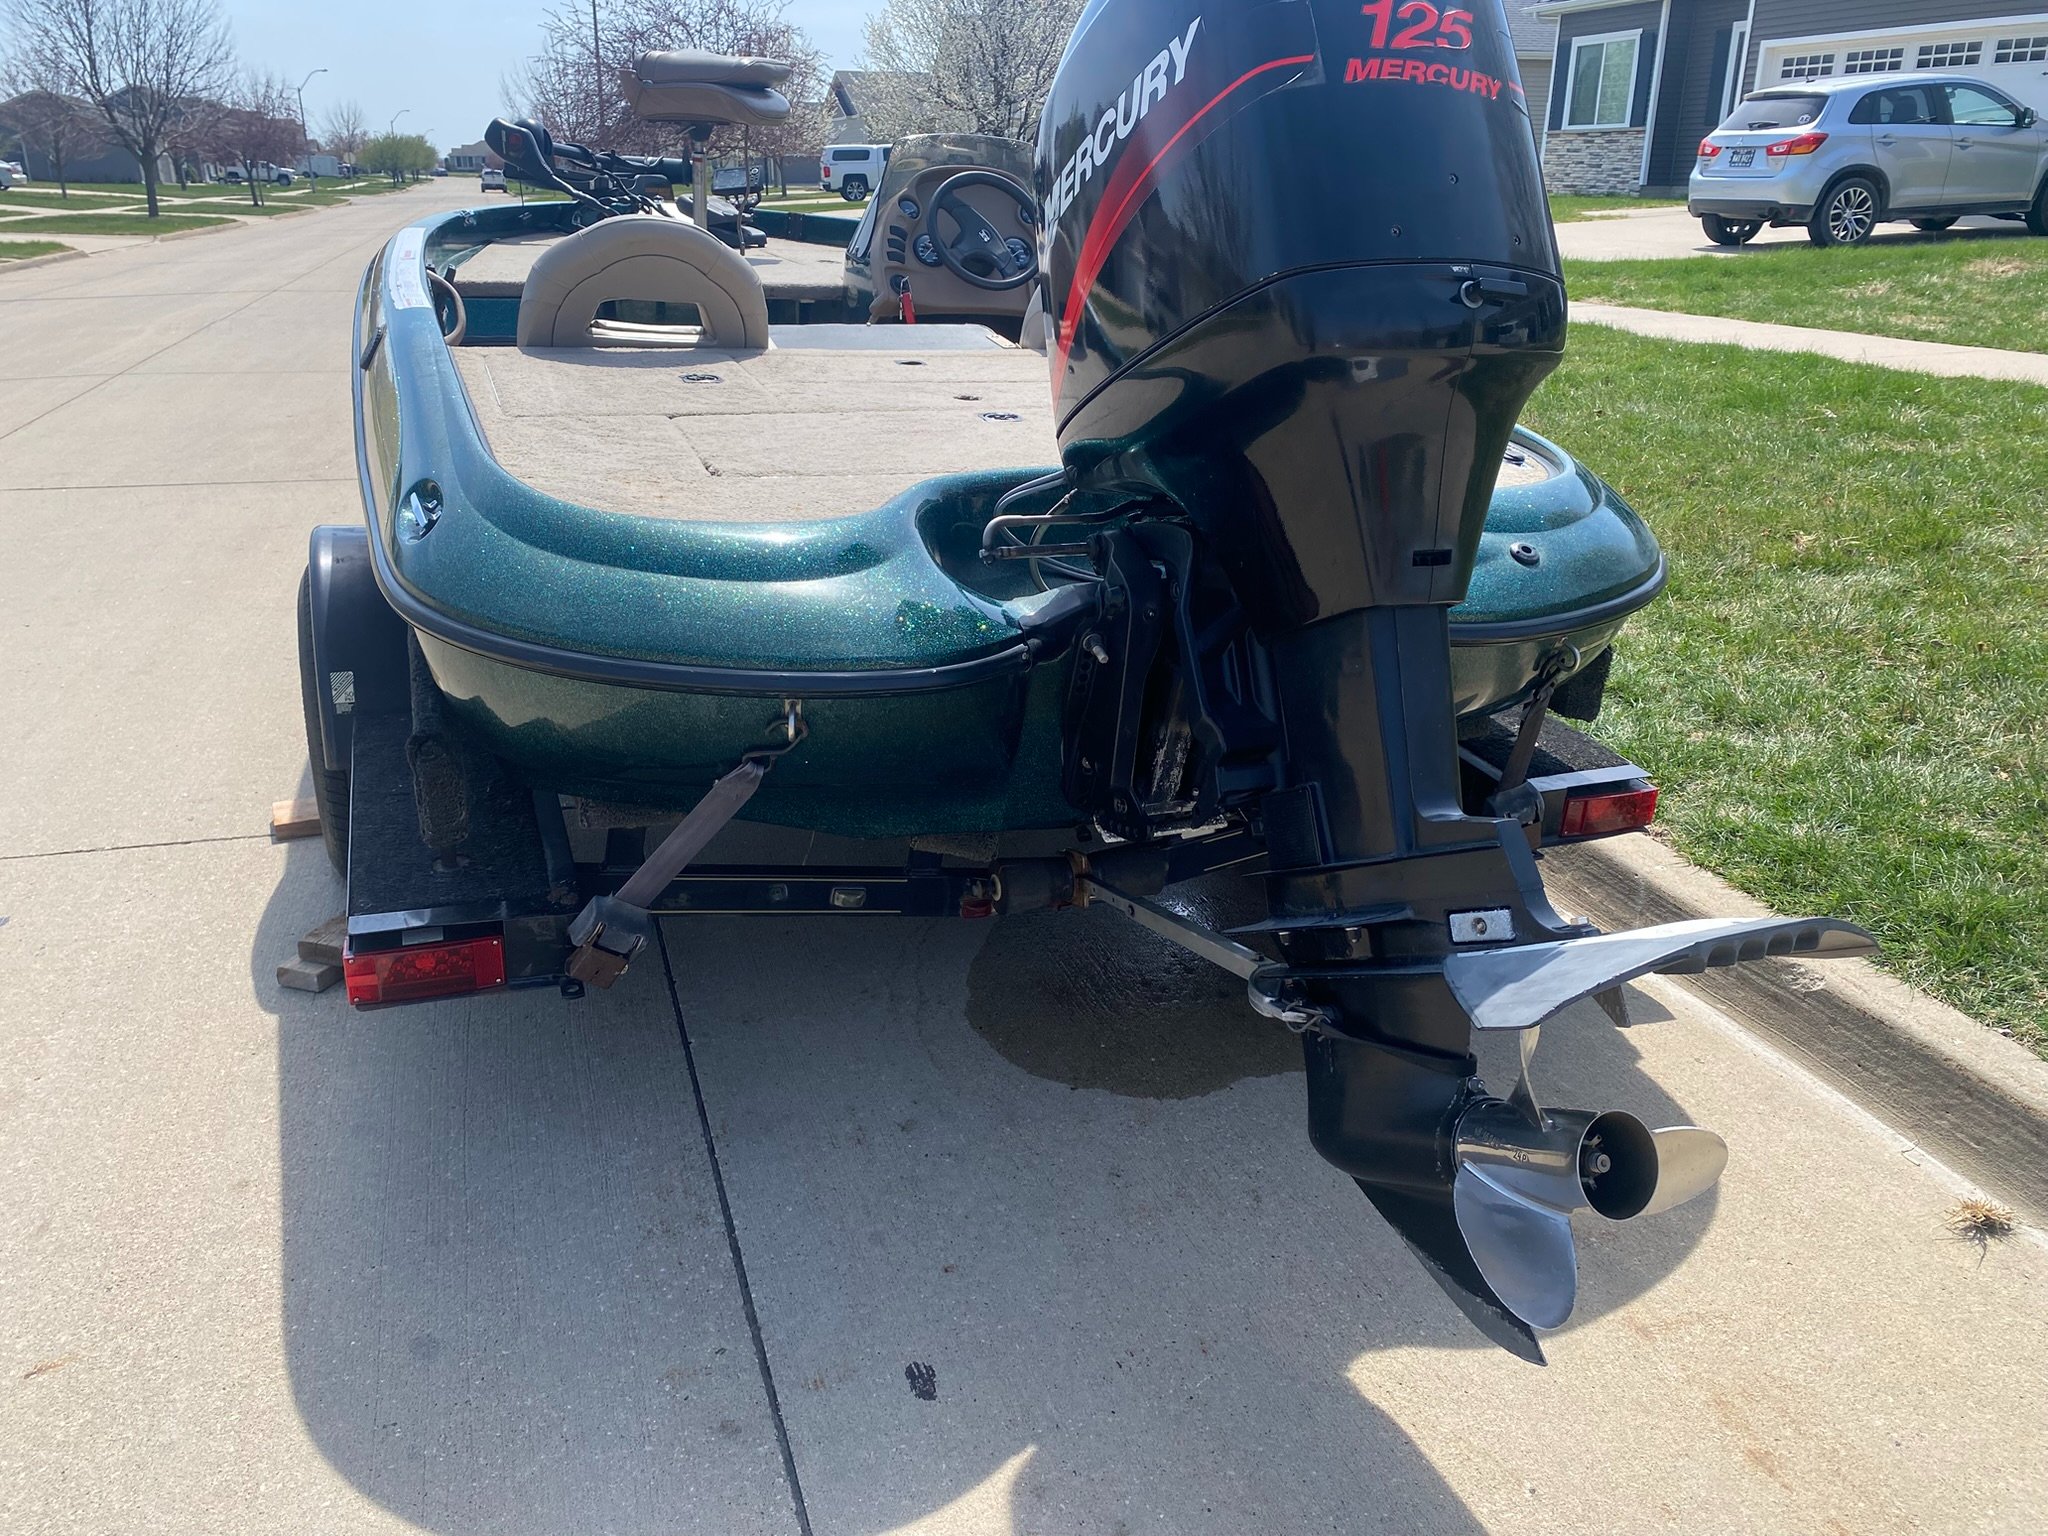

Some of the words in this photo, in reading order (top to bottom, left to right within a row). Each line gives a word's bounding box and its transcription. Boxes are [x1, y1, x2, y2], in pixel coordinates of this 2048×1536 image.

[1361, 0, 1473, 49] 125
[1344, 57, 1502, 100] MERCURY
[1044, 15, 1202, 240] MERCURY
